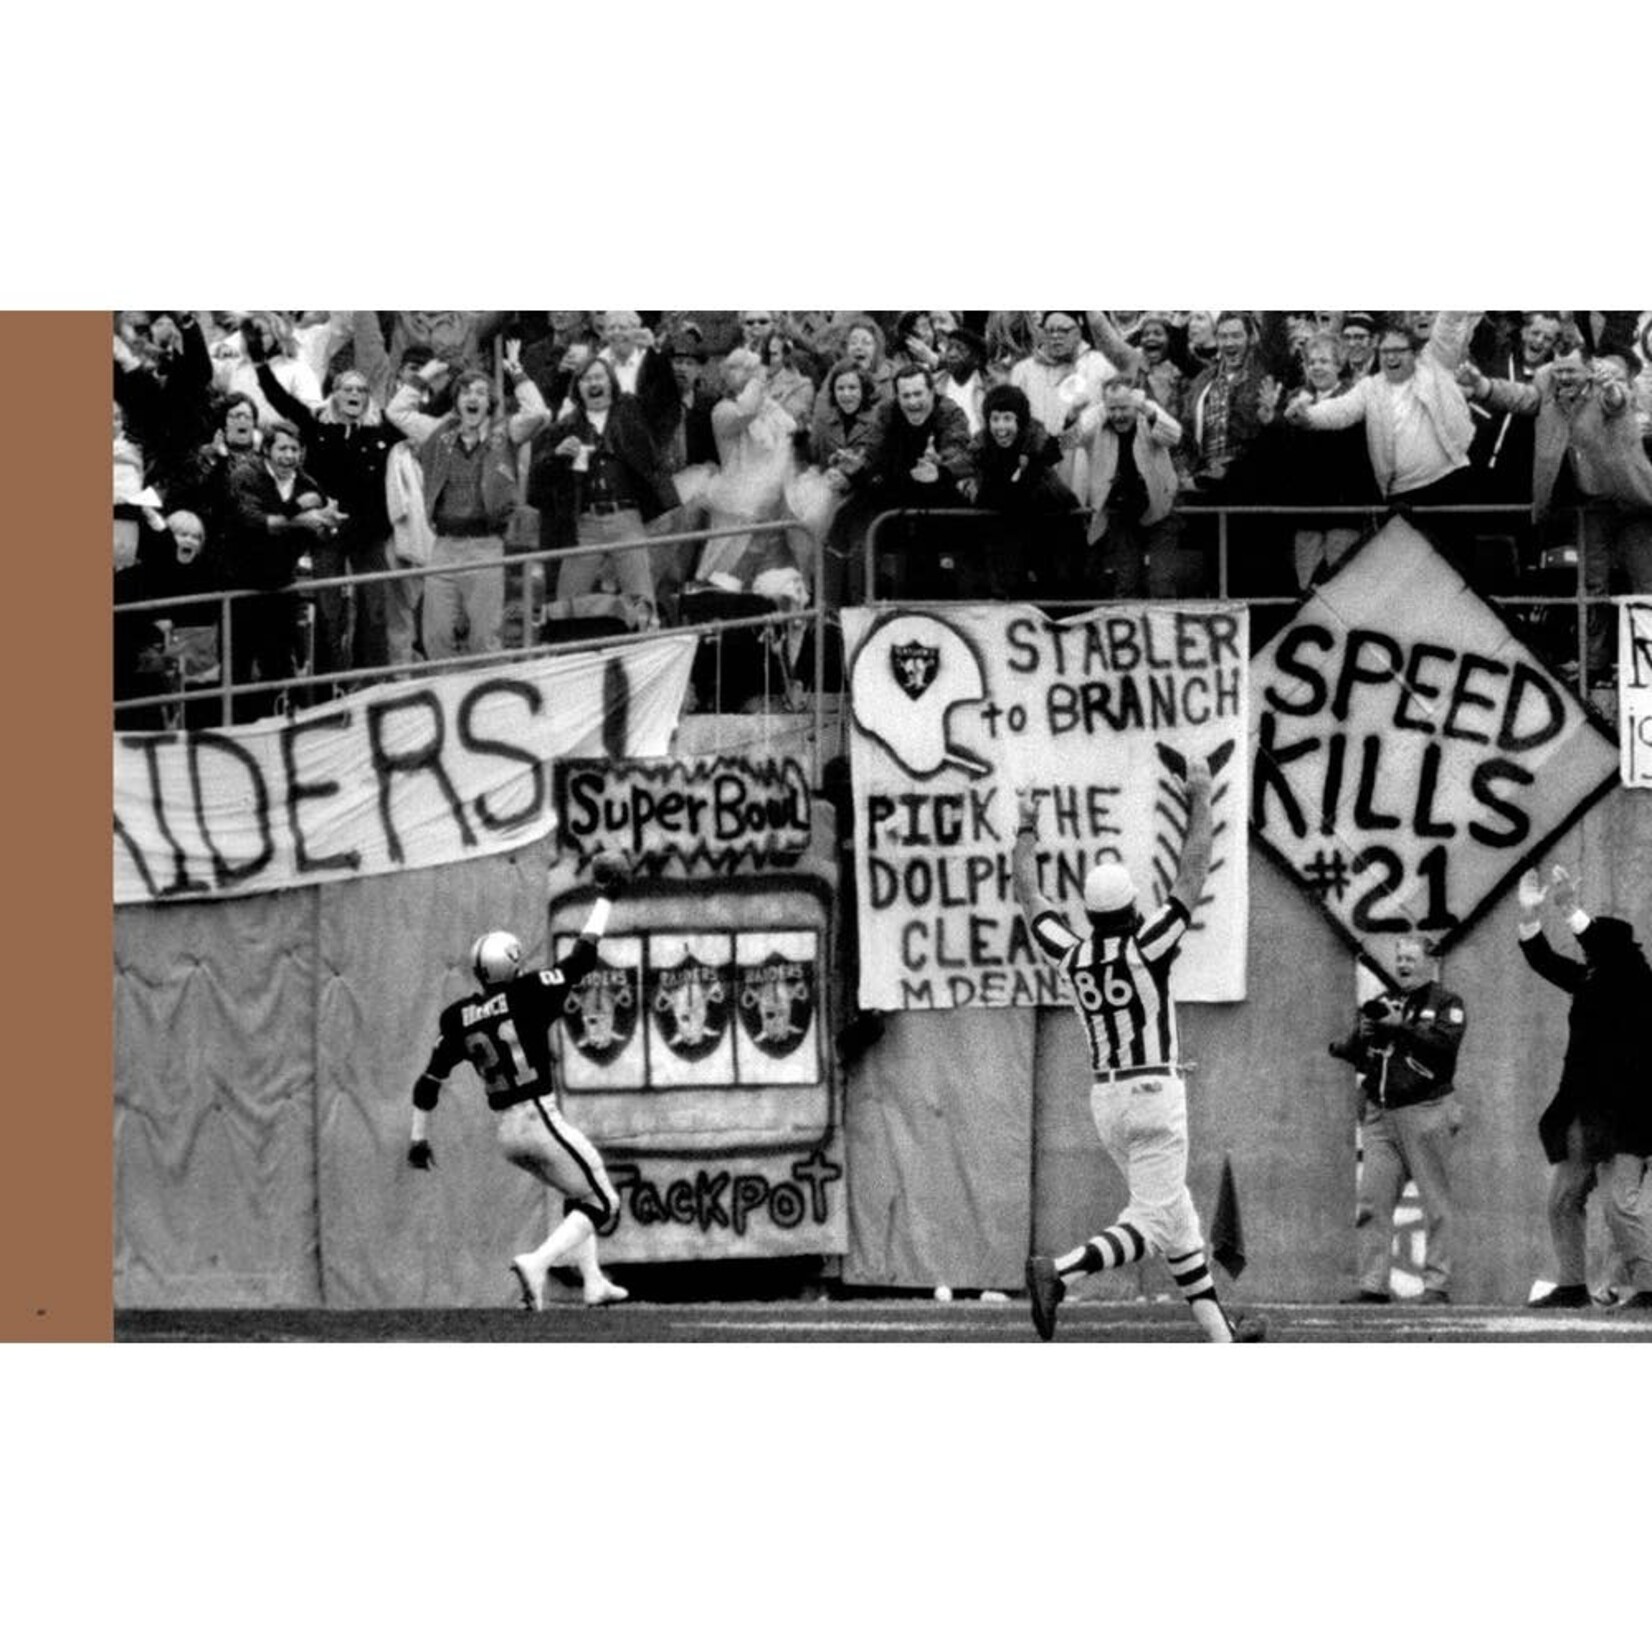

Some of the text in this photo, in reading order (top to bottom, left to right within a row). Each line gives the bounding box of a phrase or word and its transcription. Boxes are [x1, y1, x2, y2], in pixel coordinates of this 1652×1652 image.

[1006, 613, 1240, 675] STABLER
[980, 667, 1240, 738] to BRANCH
[1264, 624, 1565, 752] SPEED
[568, 772, 706, 852] Super
[1253, 711, 1535, 848] KILLS
[868, 786, 1000, 850] PICK
[1303, 844, 1459, 933] #21
[901, 916, 1042, 970] CLEA
[1073, 965, 1133, 1011] 86
[463, 1018, 539, 1093] 21
